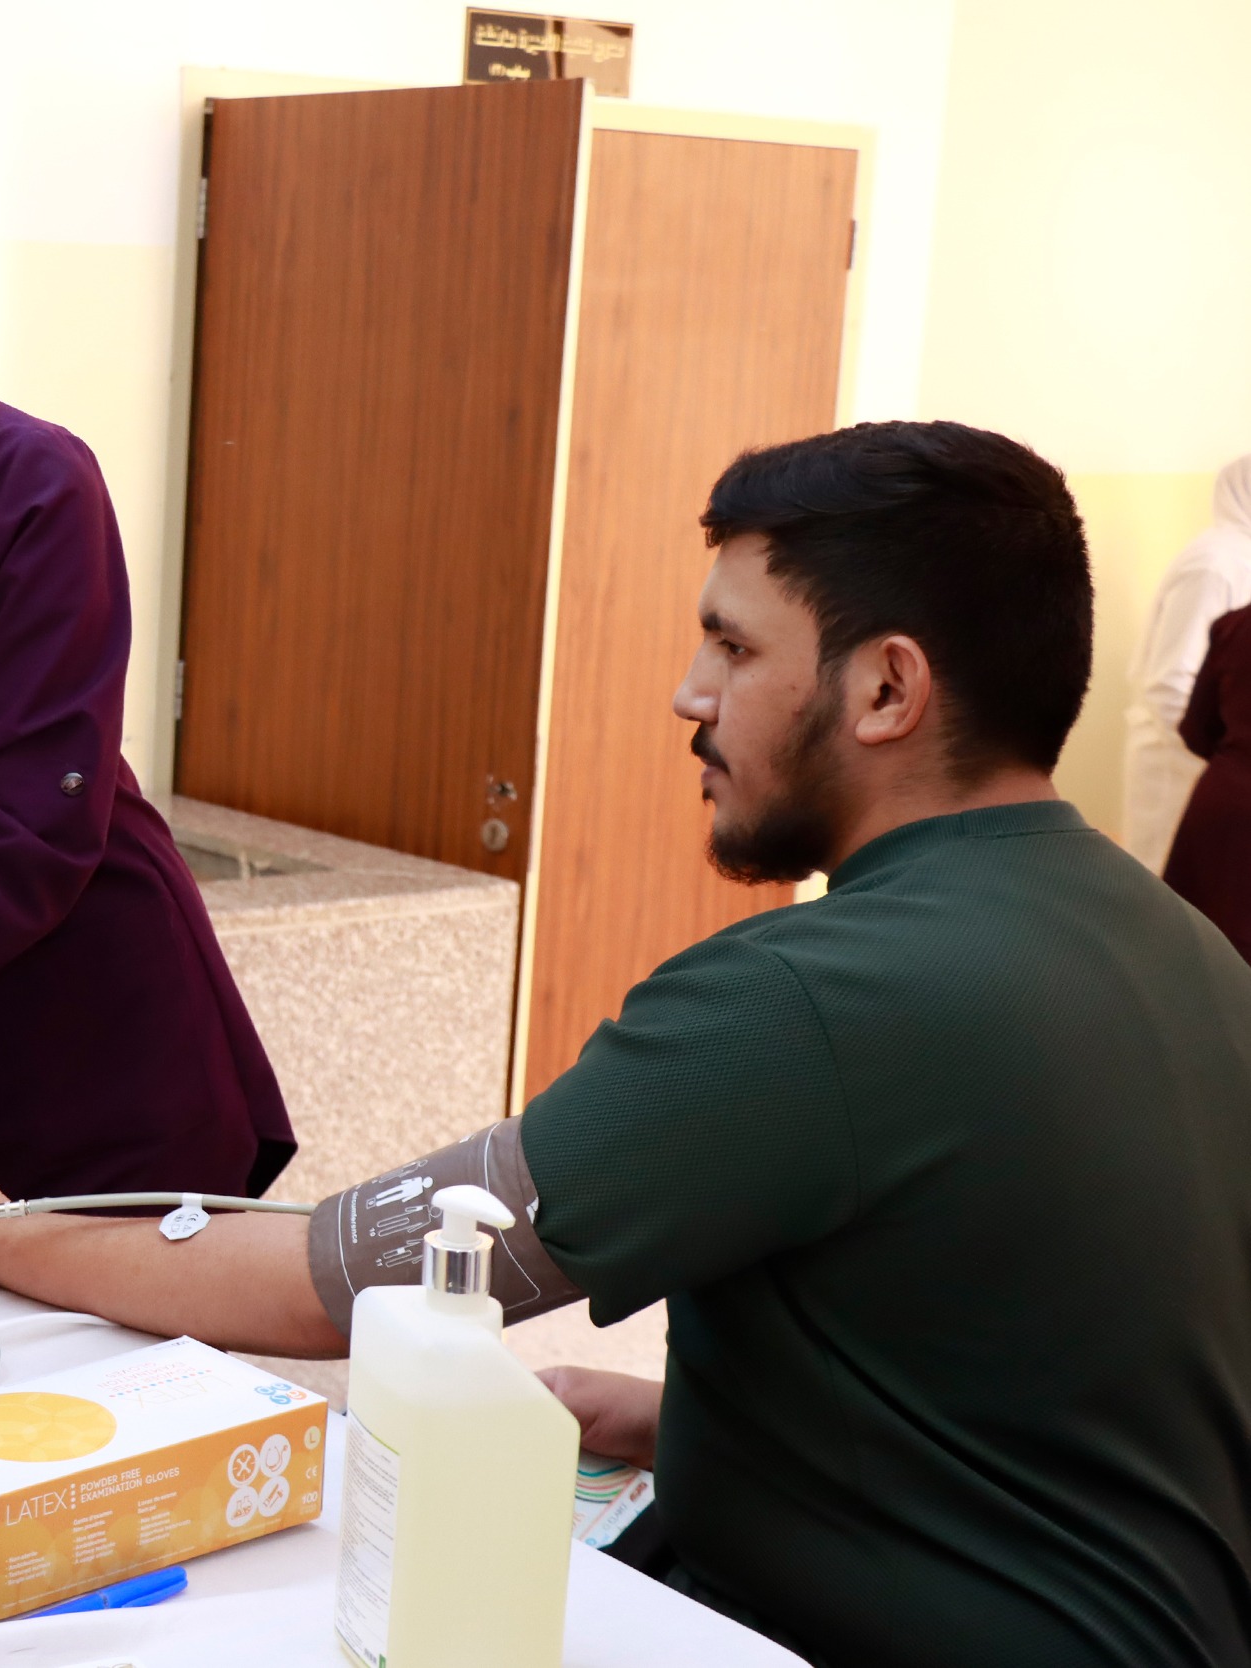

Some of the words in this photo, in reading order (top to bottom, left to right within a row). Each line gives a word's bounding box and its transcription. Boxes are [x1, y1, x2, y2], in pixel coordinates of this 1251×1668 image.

[80, 1474, 118, 1493] POWDER
[120, 1467, 141, 1482] FREE
[81, 1479, 143, 1504] EXAMINATION
[145, 1467, 180, 1485] GLOVES
[6, 1488, 68, 1526] LATEX
[302, 1491, 318, 1505] 100
